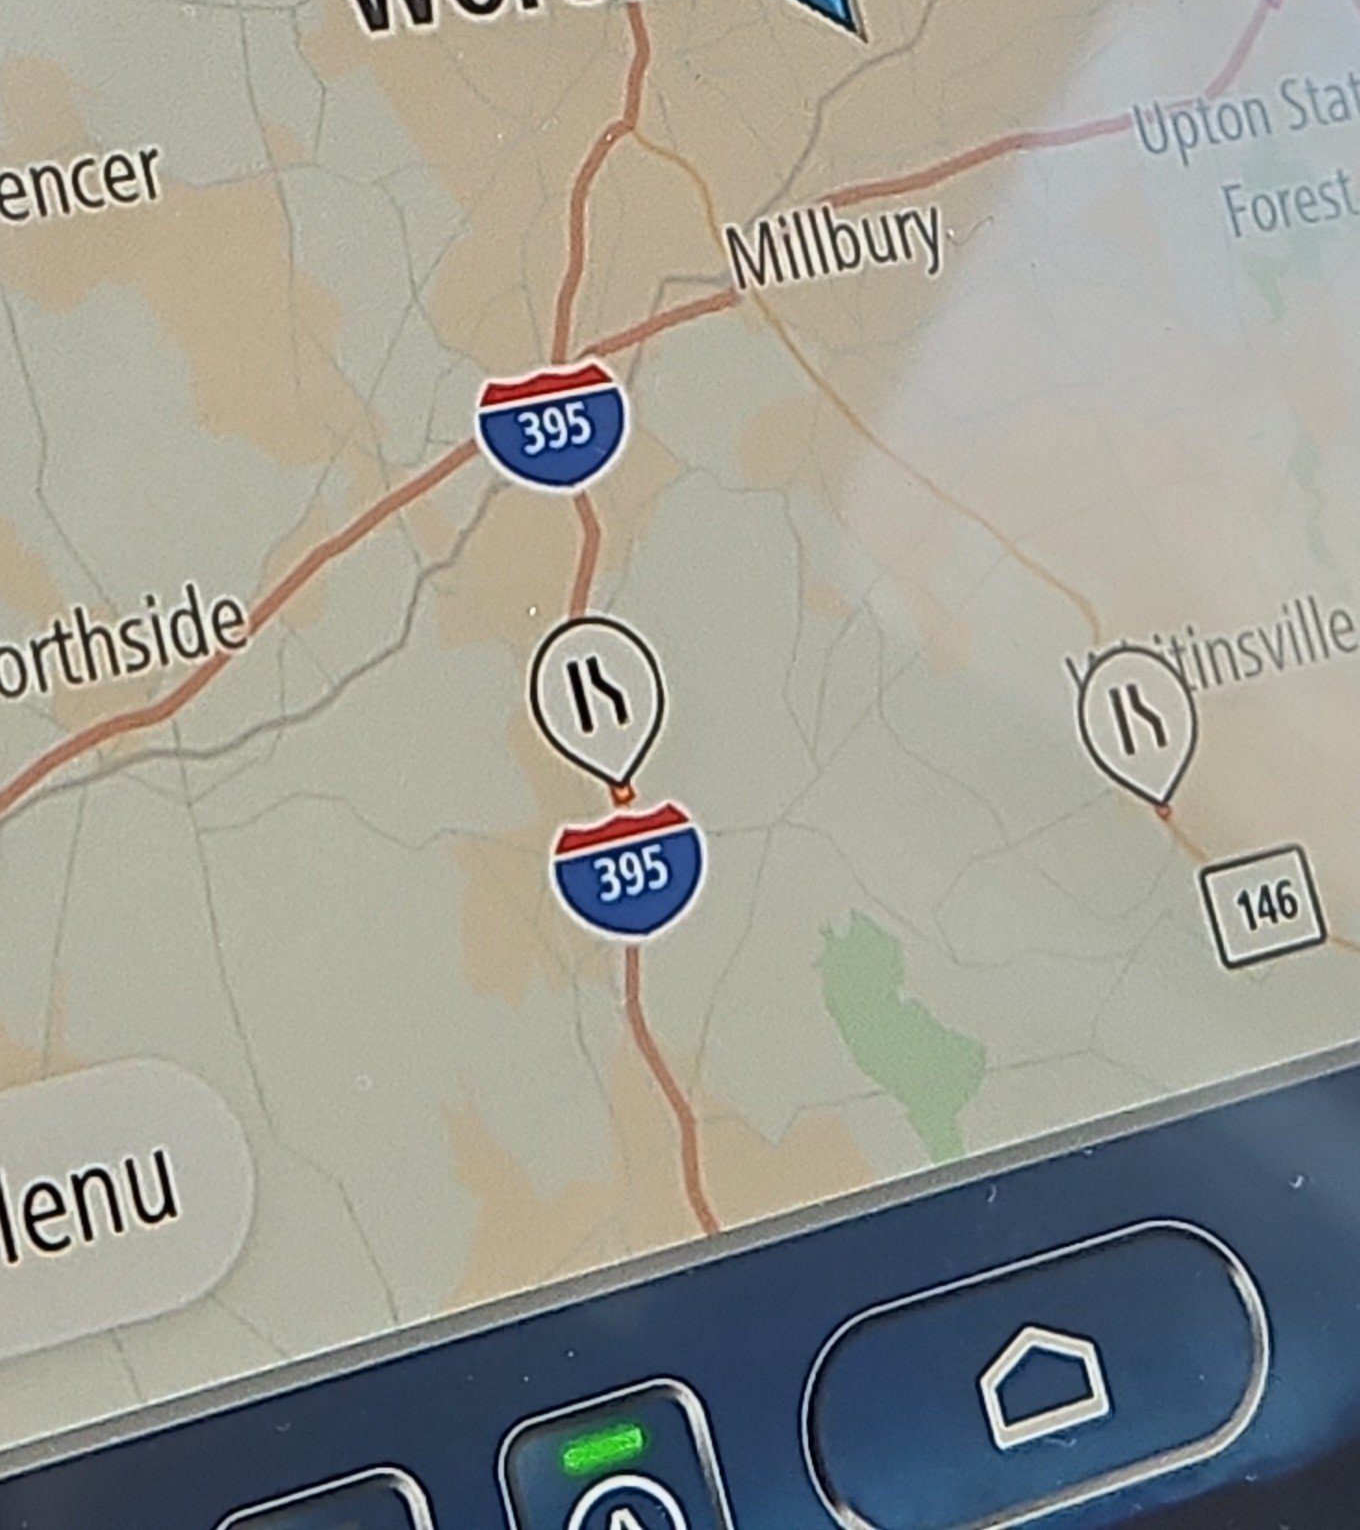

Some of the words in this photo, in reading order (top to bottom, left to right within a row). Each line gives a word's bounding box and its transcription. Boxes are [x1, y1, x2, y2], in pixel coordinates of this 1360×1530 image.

[1130, 95, 1273, 168] Upton
[1222, 172, 1359, 239] Forest
[724, 202, 943, 290] Millbury
[518, 400, 593, 457] 395
[1066, 596, 1359, 692] tinsville
[593, 843, 670, 903] 395
[1236, 879, 1299, 933] 146
